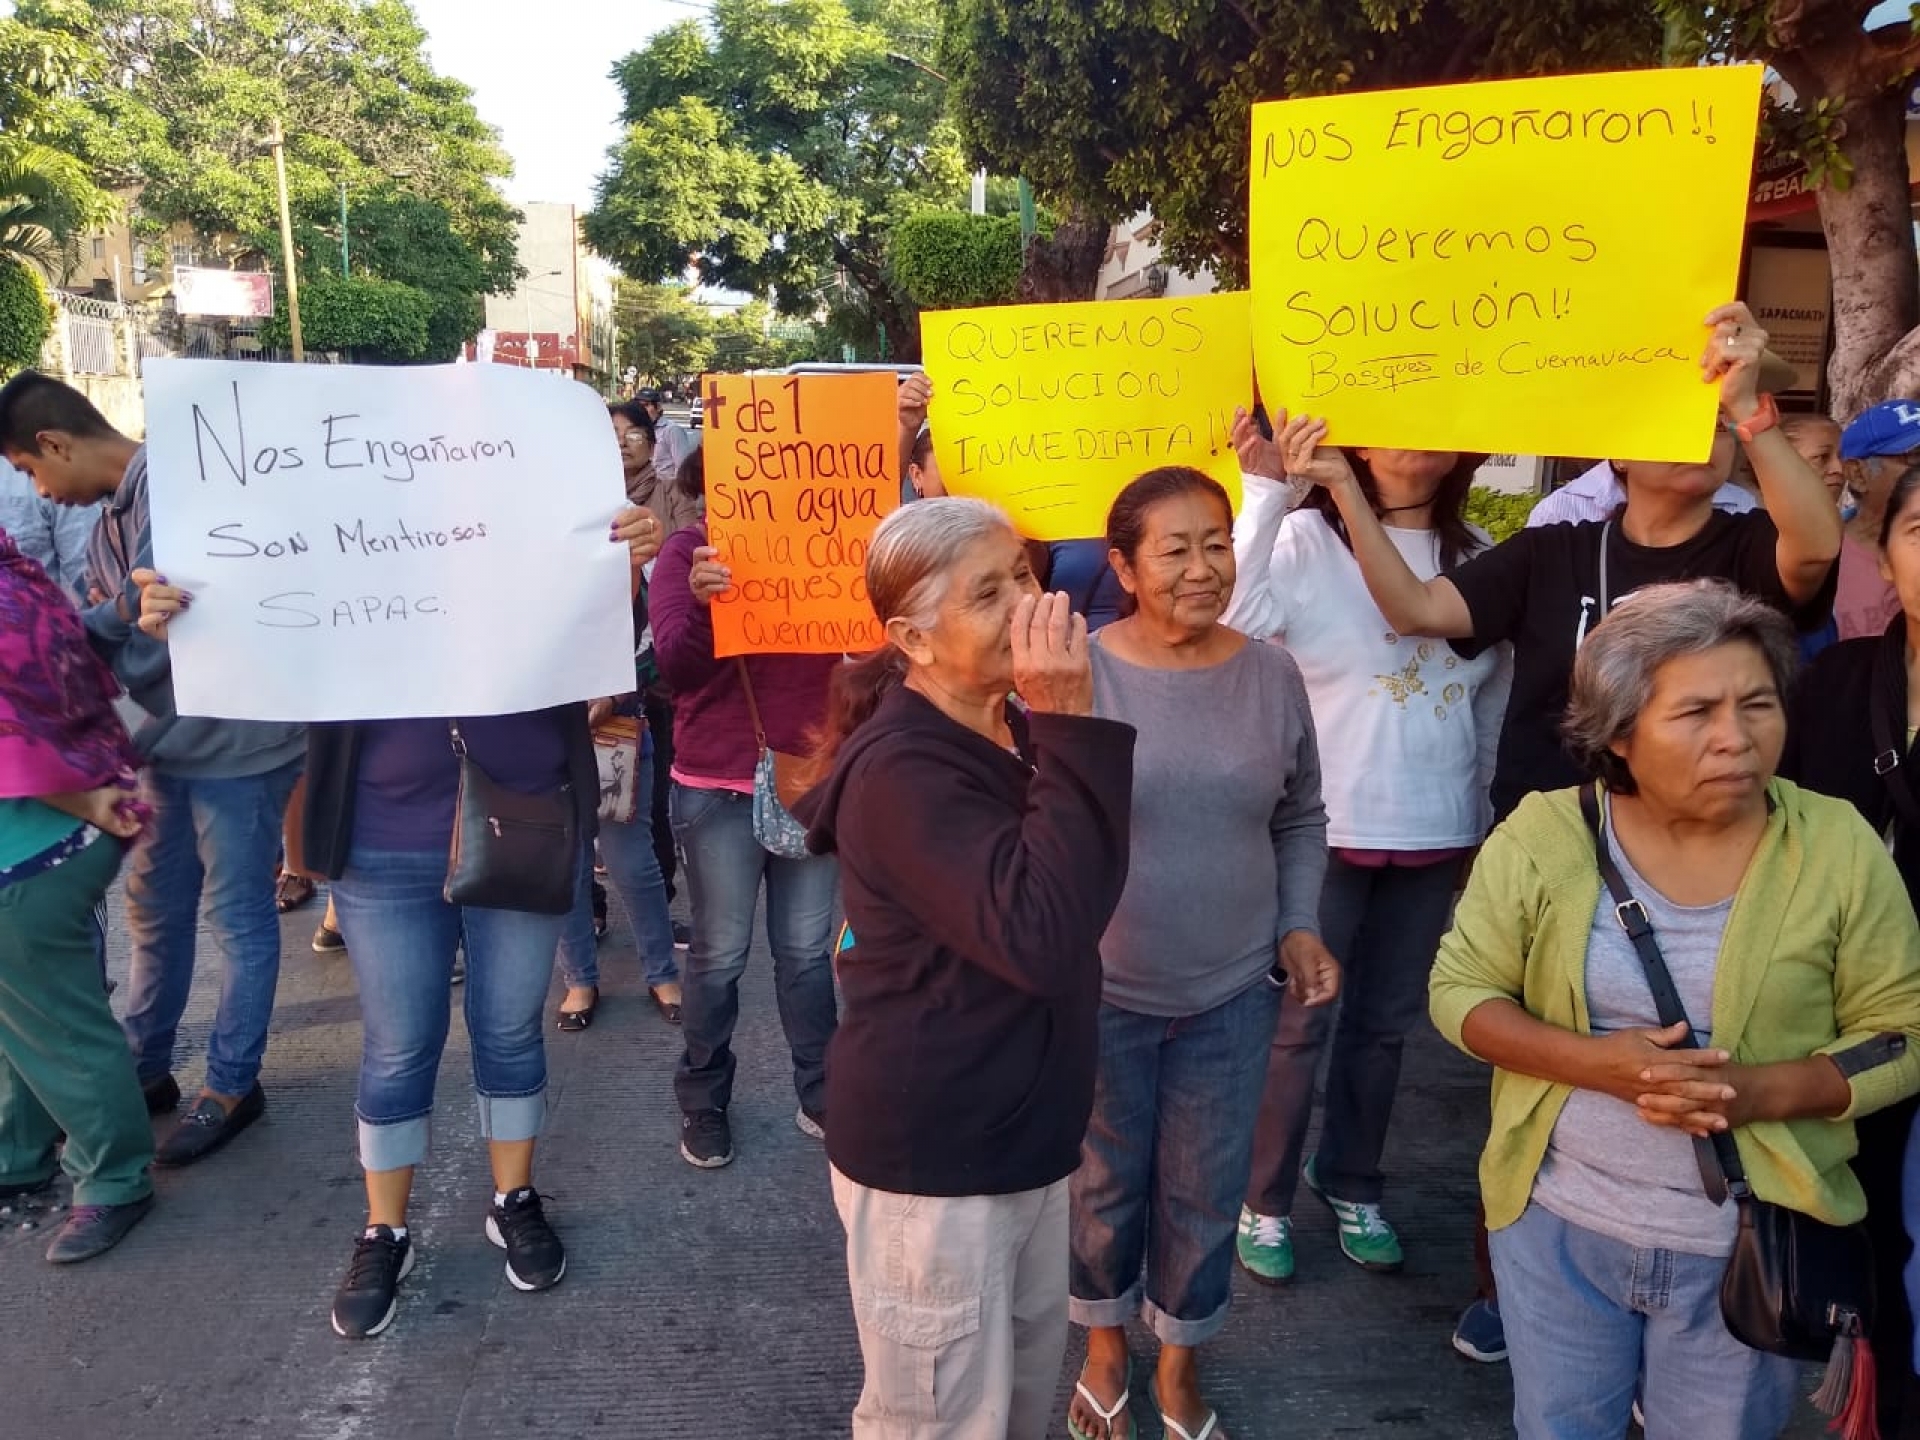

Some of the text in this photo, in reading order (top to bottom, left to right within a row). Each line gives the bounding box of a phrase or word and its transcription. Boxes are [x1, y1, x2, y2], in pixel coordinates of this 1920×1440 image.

[1263, 122, 1354, 178] NOS
[1296, 217, 1597, 263] Queremos
[947, 306, 1204, 363] QUEREMOS
[1302, 342, 1690, 398] Bosques de Cuernavaca
[736, 373, 777, 433] de
[783, 377, 802, 434] 1
[192, 380, 515, 486] Nos Engañaron
[334, 518, 487, 557] Mentirosos
[797, 487, 882, 536] agua
[765, 527, 795, 566] la
